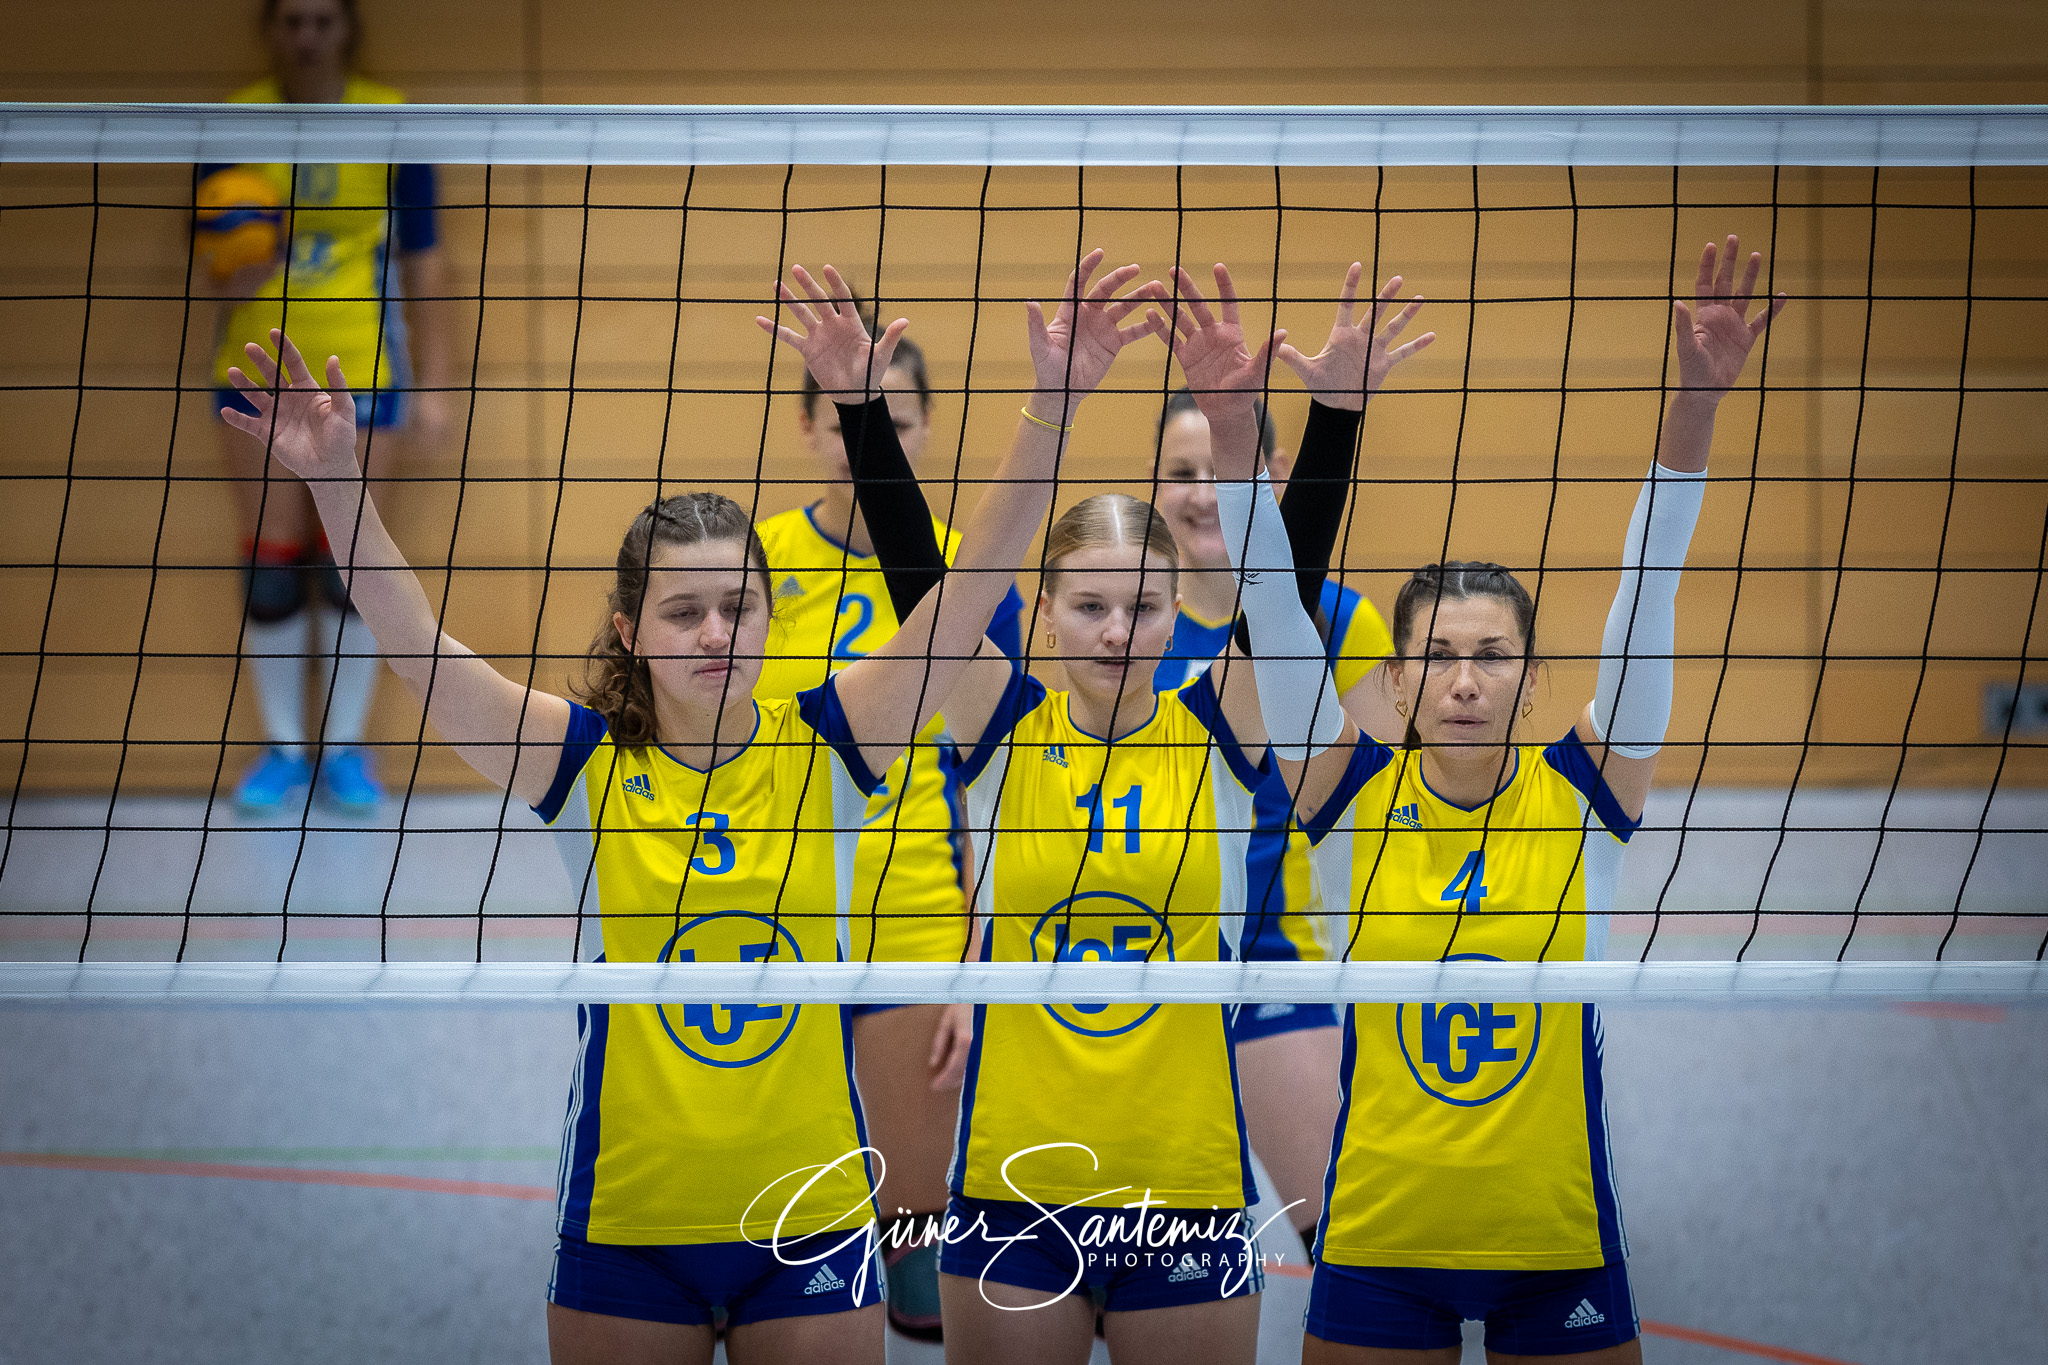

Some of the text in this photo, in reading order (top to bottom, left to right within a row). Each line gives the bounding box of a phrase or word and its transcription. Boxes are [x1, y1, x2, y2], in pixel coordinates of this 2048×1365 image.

[831, 593, 874, 662] 2
[1043, 751, 1069, 768] didas
[1075, 783, 1143, 854] 11
[685, 811, 736, 875] 3
[1440, 850, 1488, 914] 4
[804, 1279, 846, 1295] adidas
[1168, 1268, 1209, 1283] adidas
[1564, 1312, 1605, 1329] adidas
